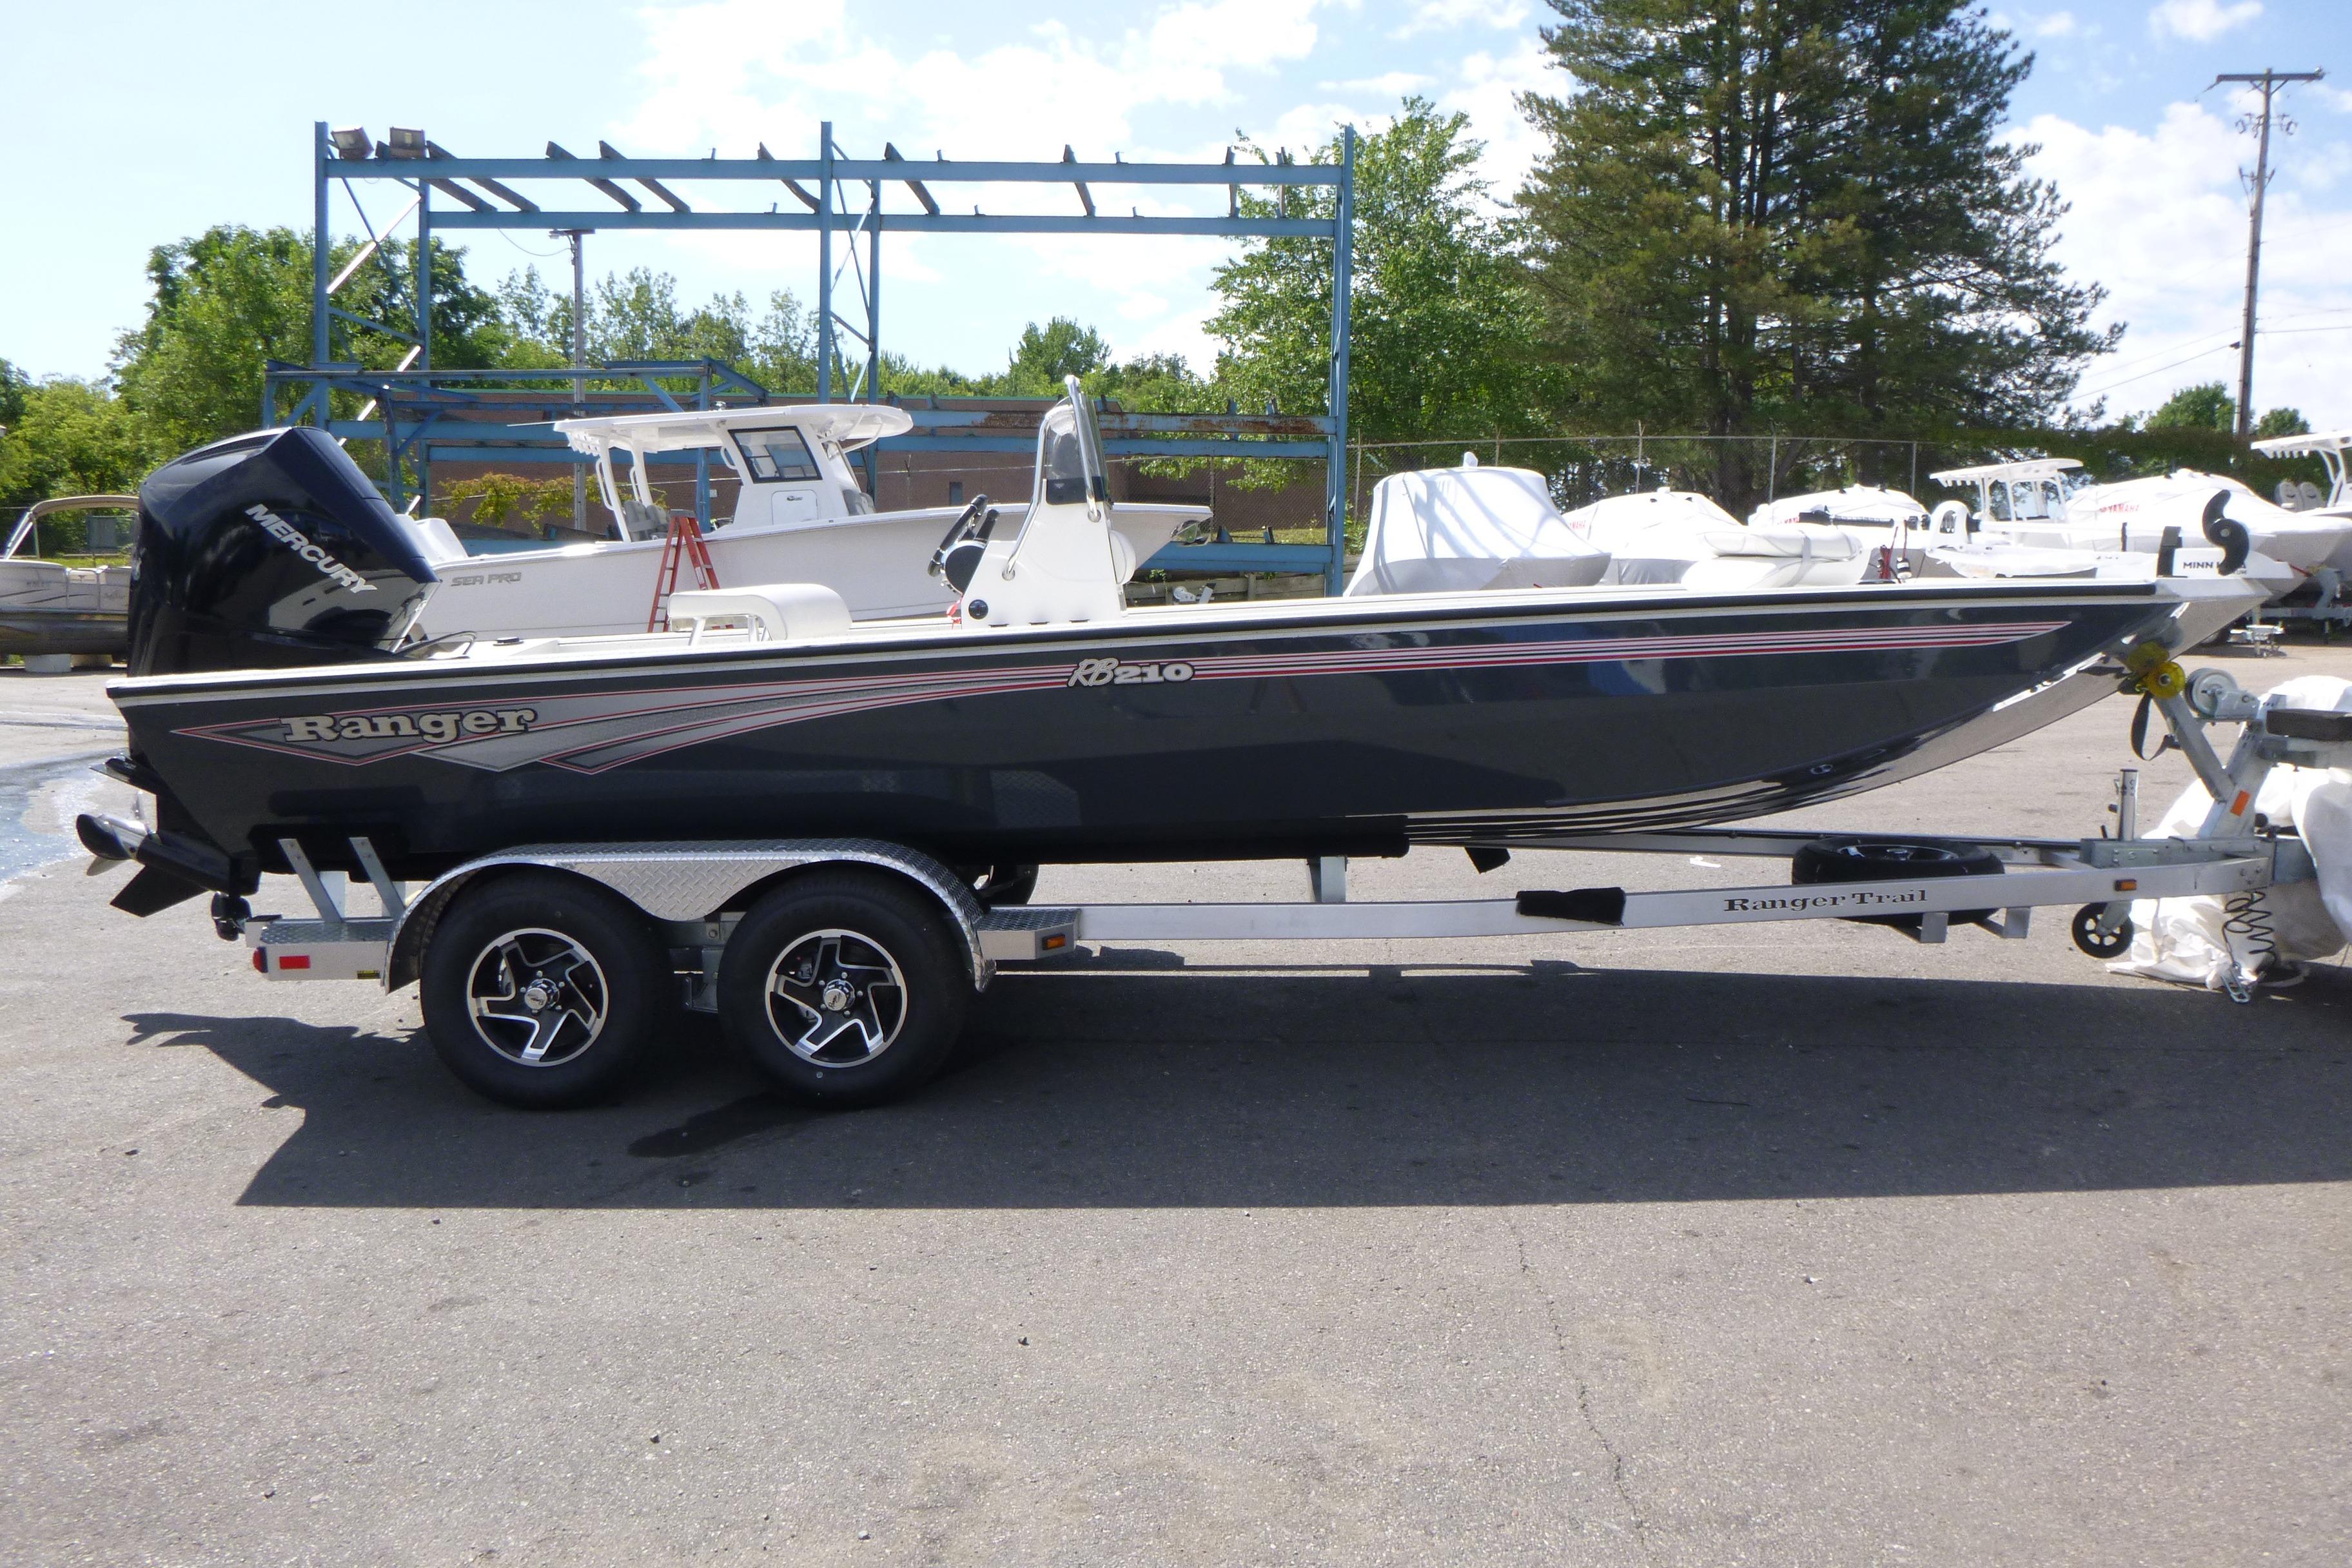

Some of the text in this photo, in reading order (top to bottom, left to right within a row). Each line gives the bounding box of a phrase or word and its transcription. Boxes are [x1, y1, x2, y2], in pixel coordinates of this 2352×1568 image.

[244, 504, 378, 593] MERCURY
[451, 572, 522, 587] SEA PRO
[279, 708, 539, 743] Ranger
[1723, 890, 1928, 912] Ranger Trail
